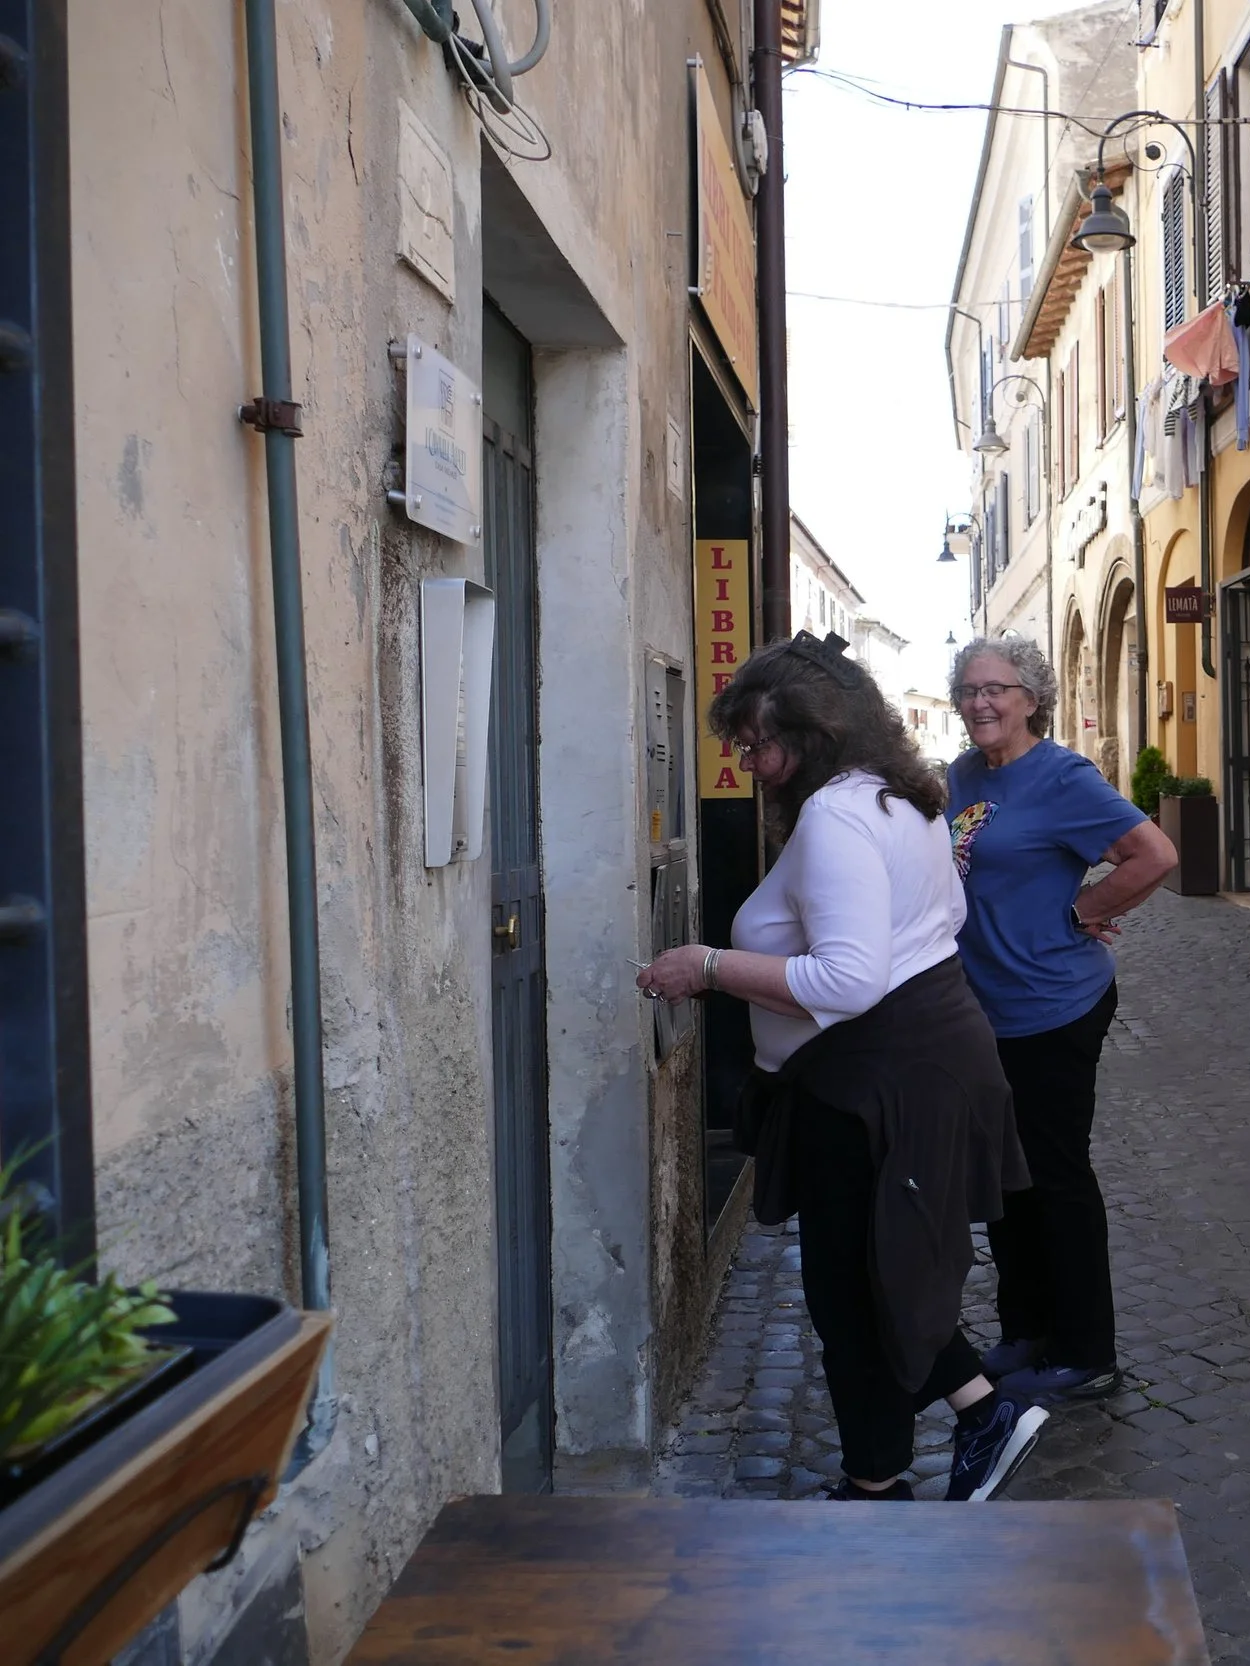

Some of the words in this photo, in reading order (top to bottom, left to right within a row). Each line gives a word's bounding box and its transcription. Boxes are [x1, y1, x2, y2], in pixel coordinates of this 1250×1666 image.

[701, 129, 730, 253] LIBRI
[1168, 594, 1199, 612] LEMATÀ
[711, 547, 740, 789] LIBREIA
